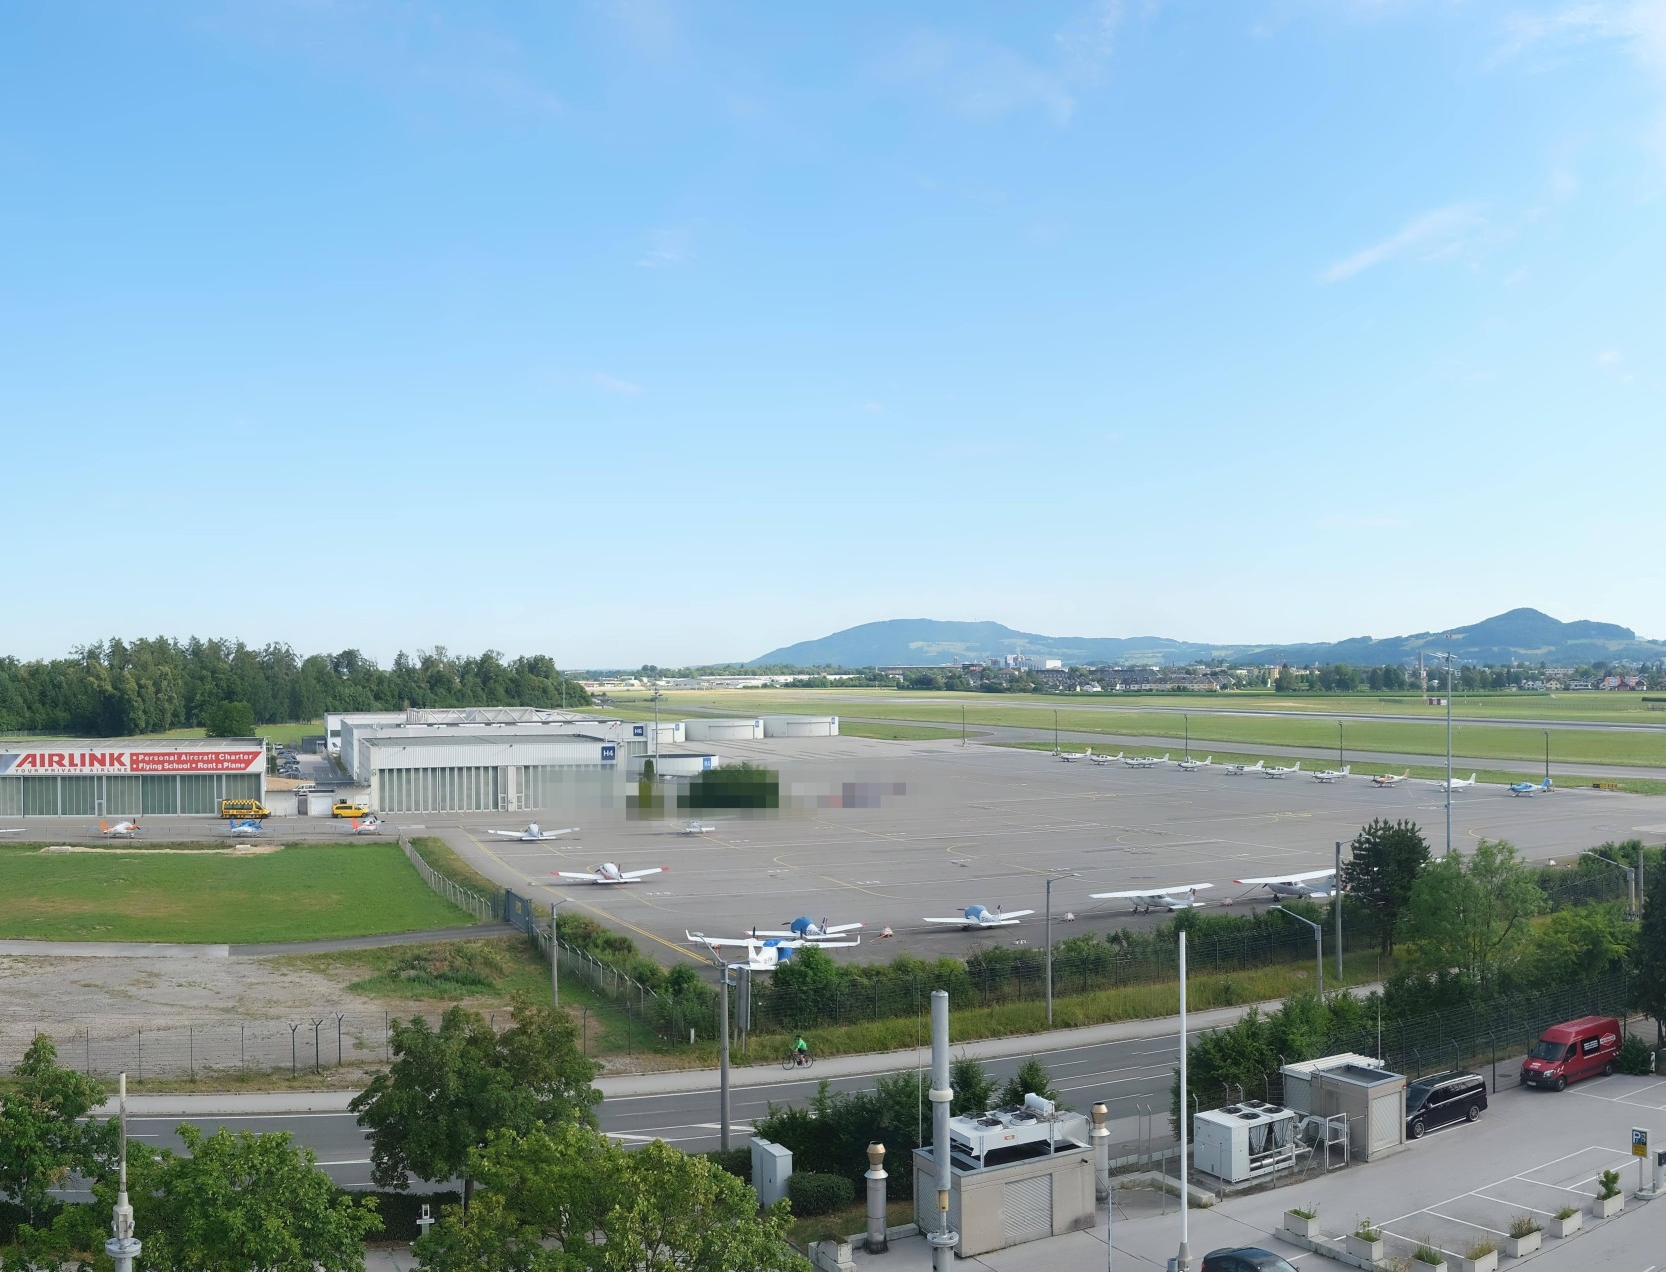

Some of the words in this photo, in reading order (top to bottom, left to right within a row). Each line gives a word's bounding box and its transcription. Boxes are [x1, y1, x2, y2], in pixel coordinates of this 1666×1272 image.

[603, 749, 614, 757] H4
[15, 753, 127, 768] AIRLINK
[1633, 1130, 1641, 1143] P
